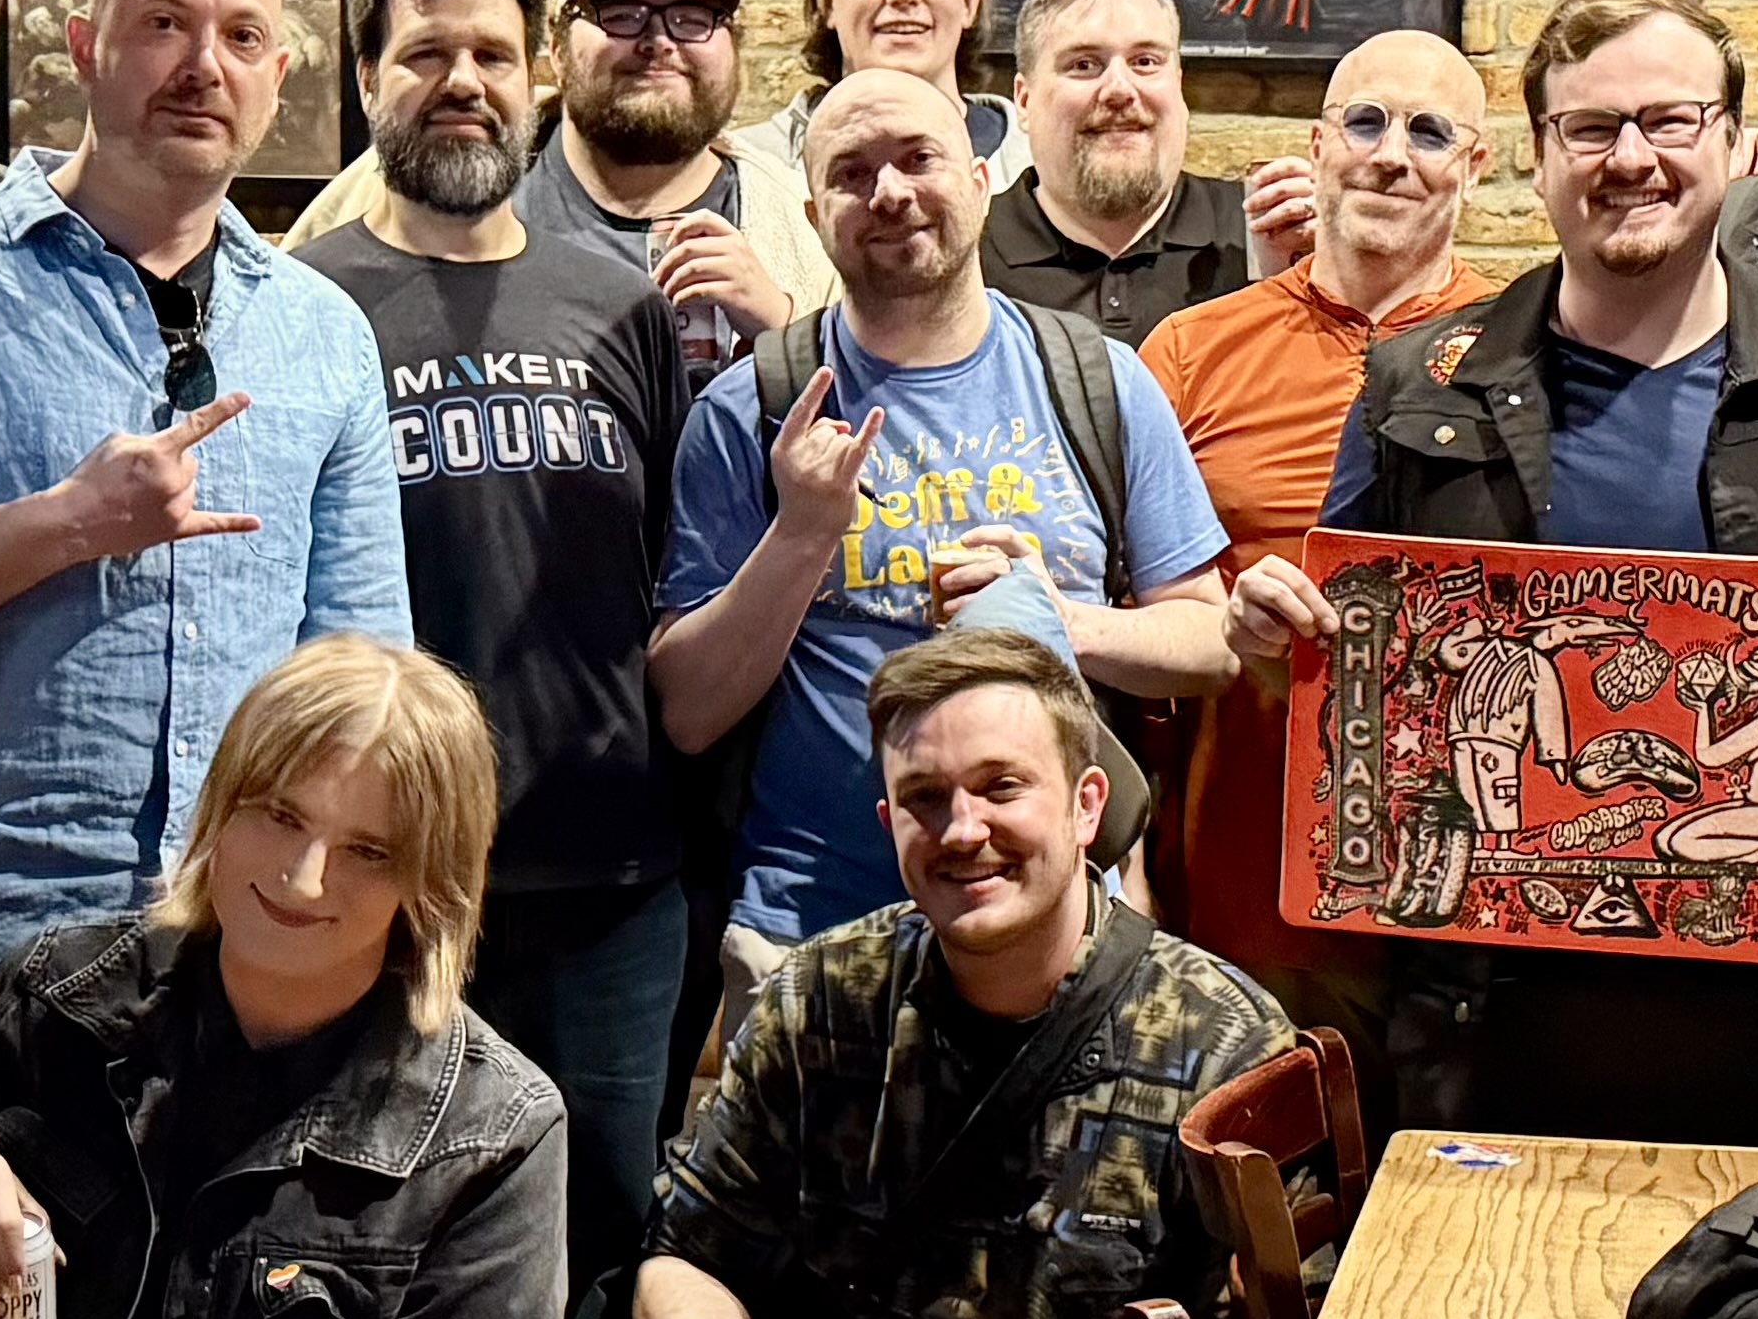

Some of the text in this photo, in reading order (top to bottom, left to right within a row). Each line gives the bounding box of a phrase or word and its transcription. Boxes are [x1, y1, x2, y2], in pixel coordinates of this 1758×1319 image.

[393, 352, 596, 398] MAKE IT
[391, 403, 617, 478] COUNT
[1342, 604, 1377, 867] CHICAGO
